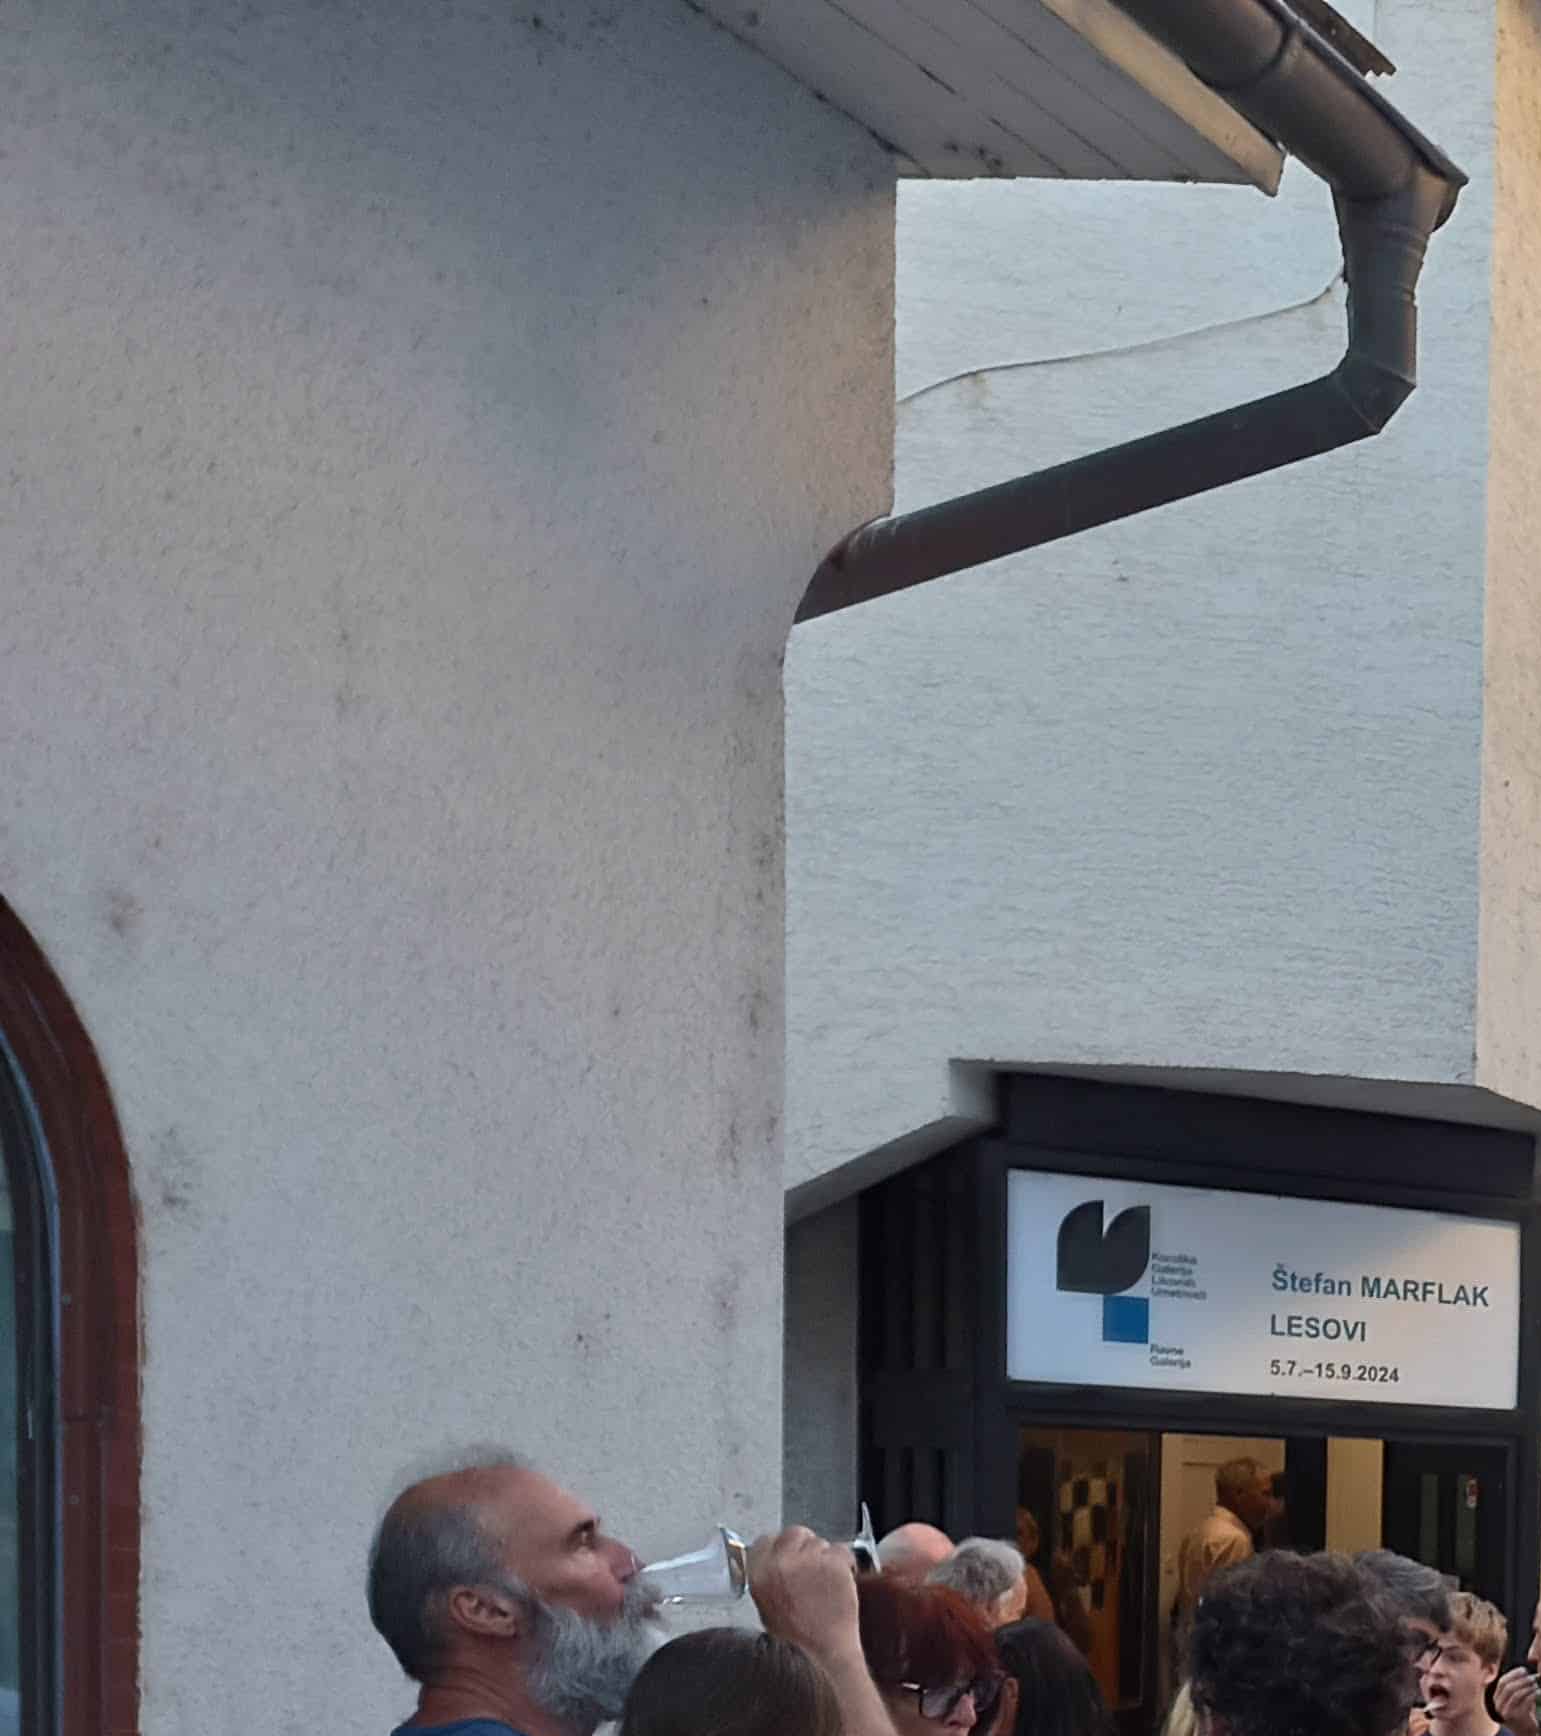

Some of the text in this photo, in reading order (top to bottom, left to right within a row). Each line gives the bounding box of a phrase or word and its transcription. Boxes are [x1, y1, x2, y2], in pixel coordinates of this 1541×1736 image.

[1271, 1262, 1489, 1307] Štefan MARFLAK
[1270, 1313, 1366, 1342] LESOVI
